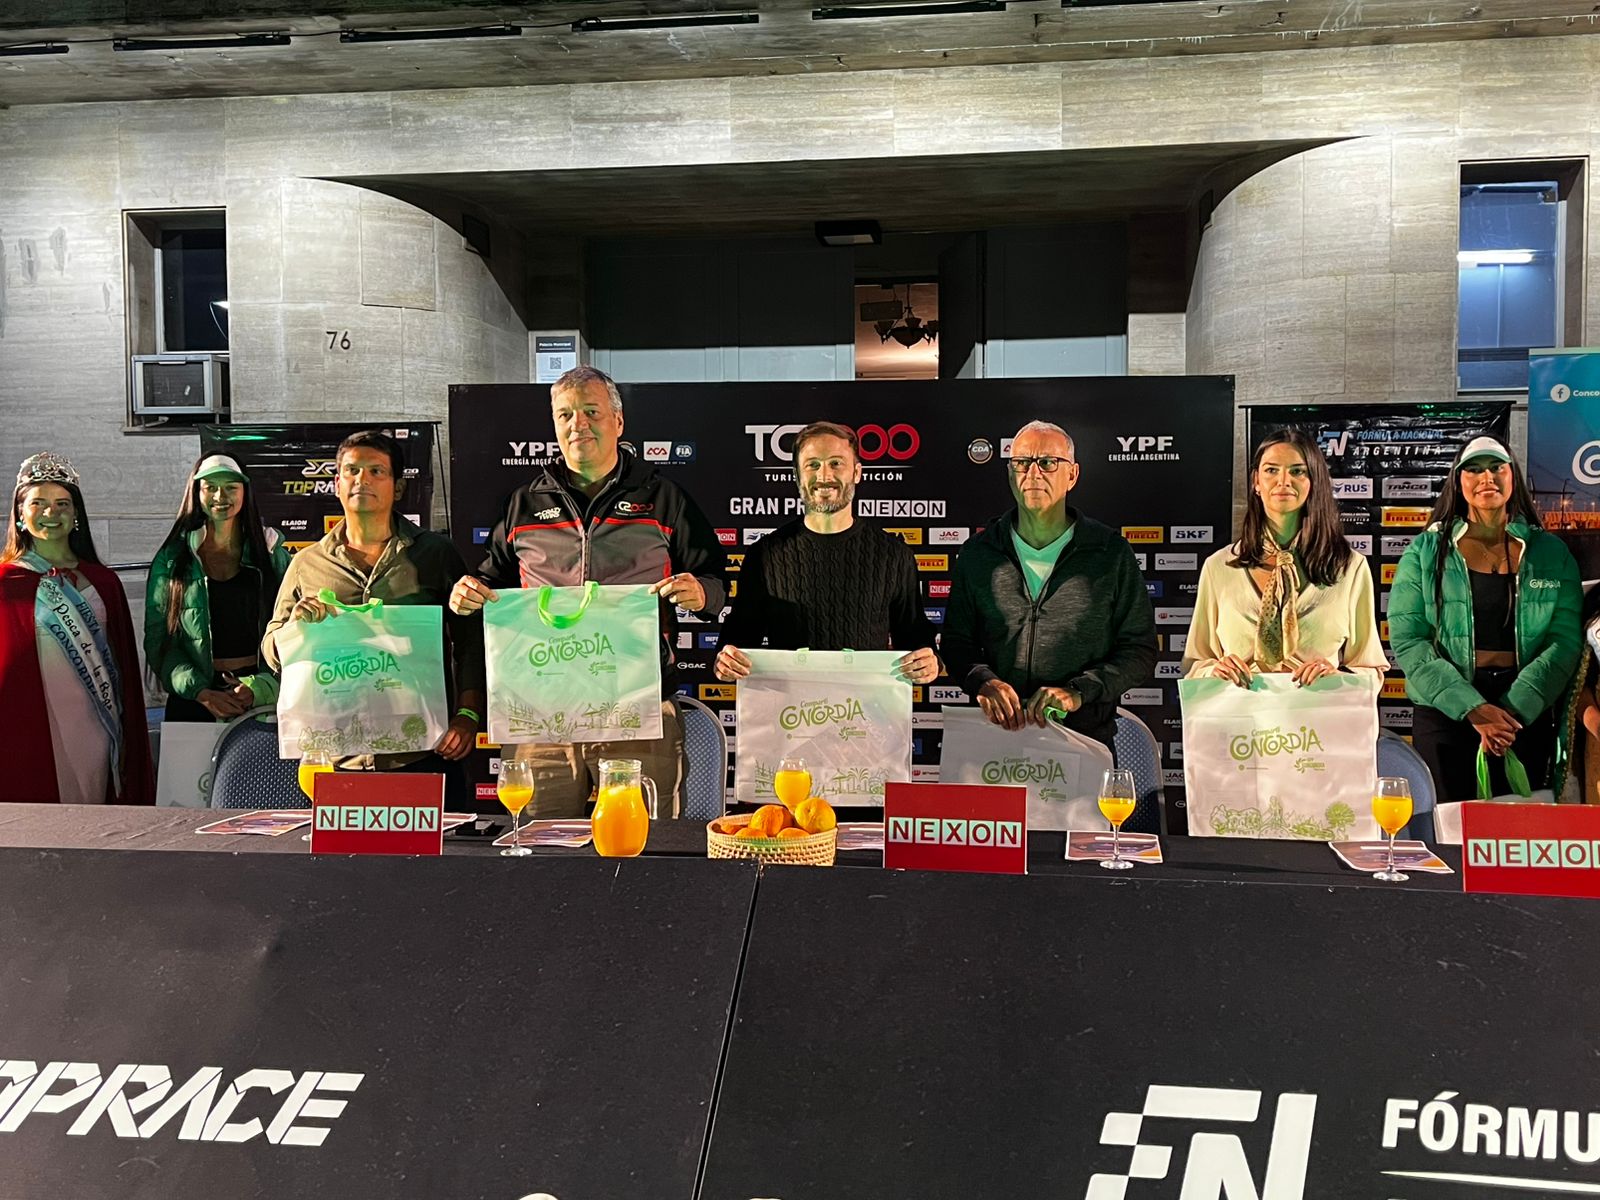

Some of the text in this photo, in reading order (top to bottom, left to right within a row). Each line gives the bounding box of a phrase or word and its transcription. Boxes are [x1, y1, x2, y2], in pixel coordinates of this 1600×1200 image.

[326, 331, 351, 350] 76
[1116, 436, 1173, 452] YPF
[675, 445, 693, 457] FIA
[1108, 453, 1180, 462] ENERGÍA ARGENTINA
[1352, 446, 1442, 456] ARGENTINA
[502, 457, 530, 466] ENERGÍA
[765, 471, 903, 482] TURIS TICIÓN
[283, 481, 335, 495] TOPRA
[1344, 484, 1368, 492] RUS
[730, 497, 946, 518] GRAN PR NEXON
[1176, 531, 1208, 539] SKF
[1350, 541, 1367, 549] US
[76, 601, 101, 635] FIESTA
[53, 603, 80, 638] Pesca
[81, 642, 91, 655] de
[93, 665, 101, 678] la
[1160, 666, 1181, 674] SK
[318, 808, 436, 829] NEXON
[892, 819, 1019, 845] NEXON
[1472, 843, 1592, 866] NEXO
